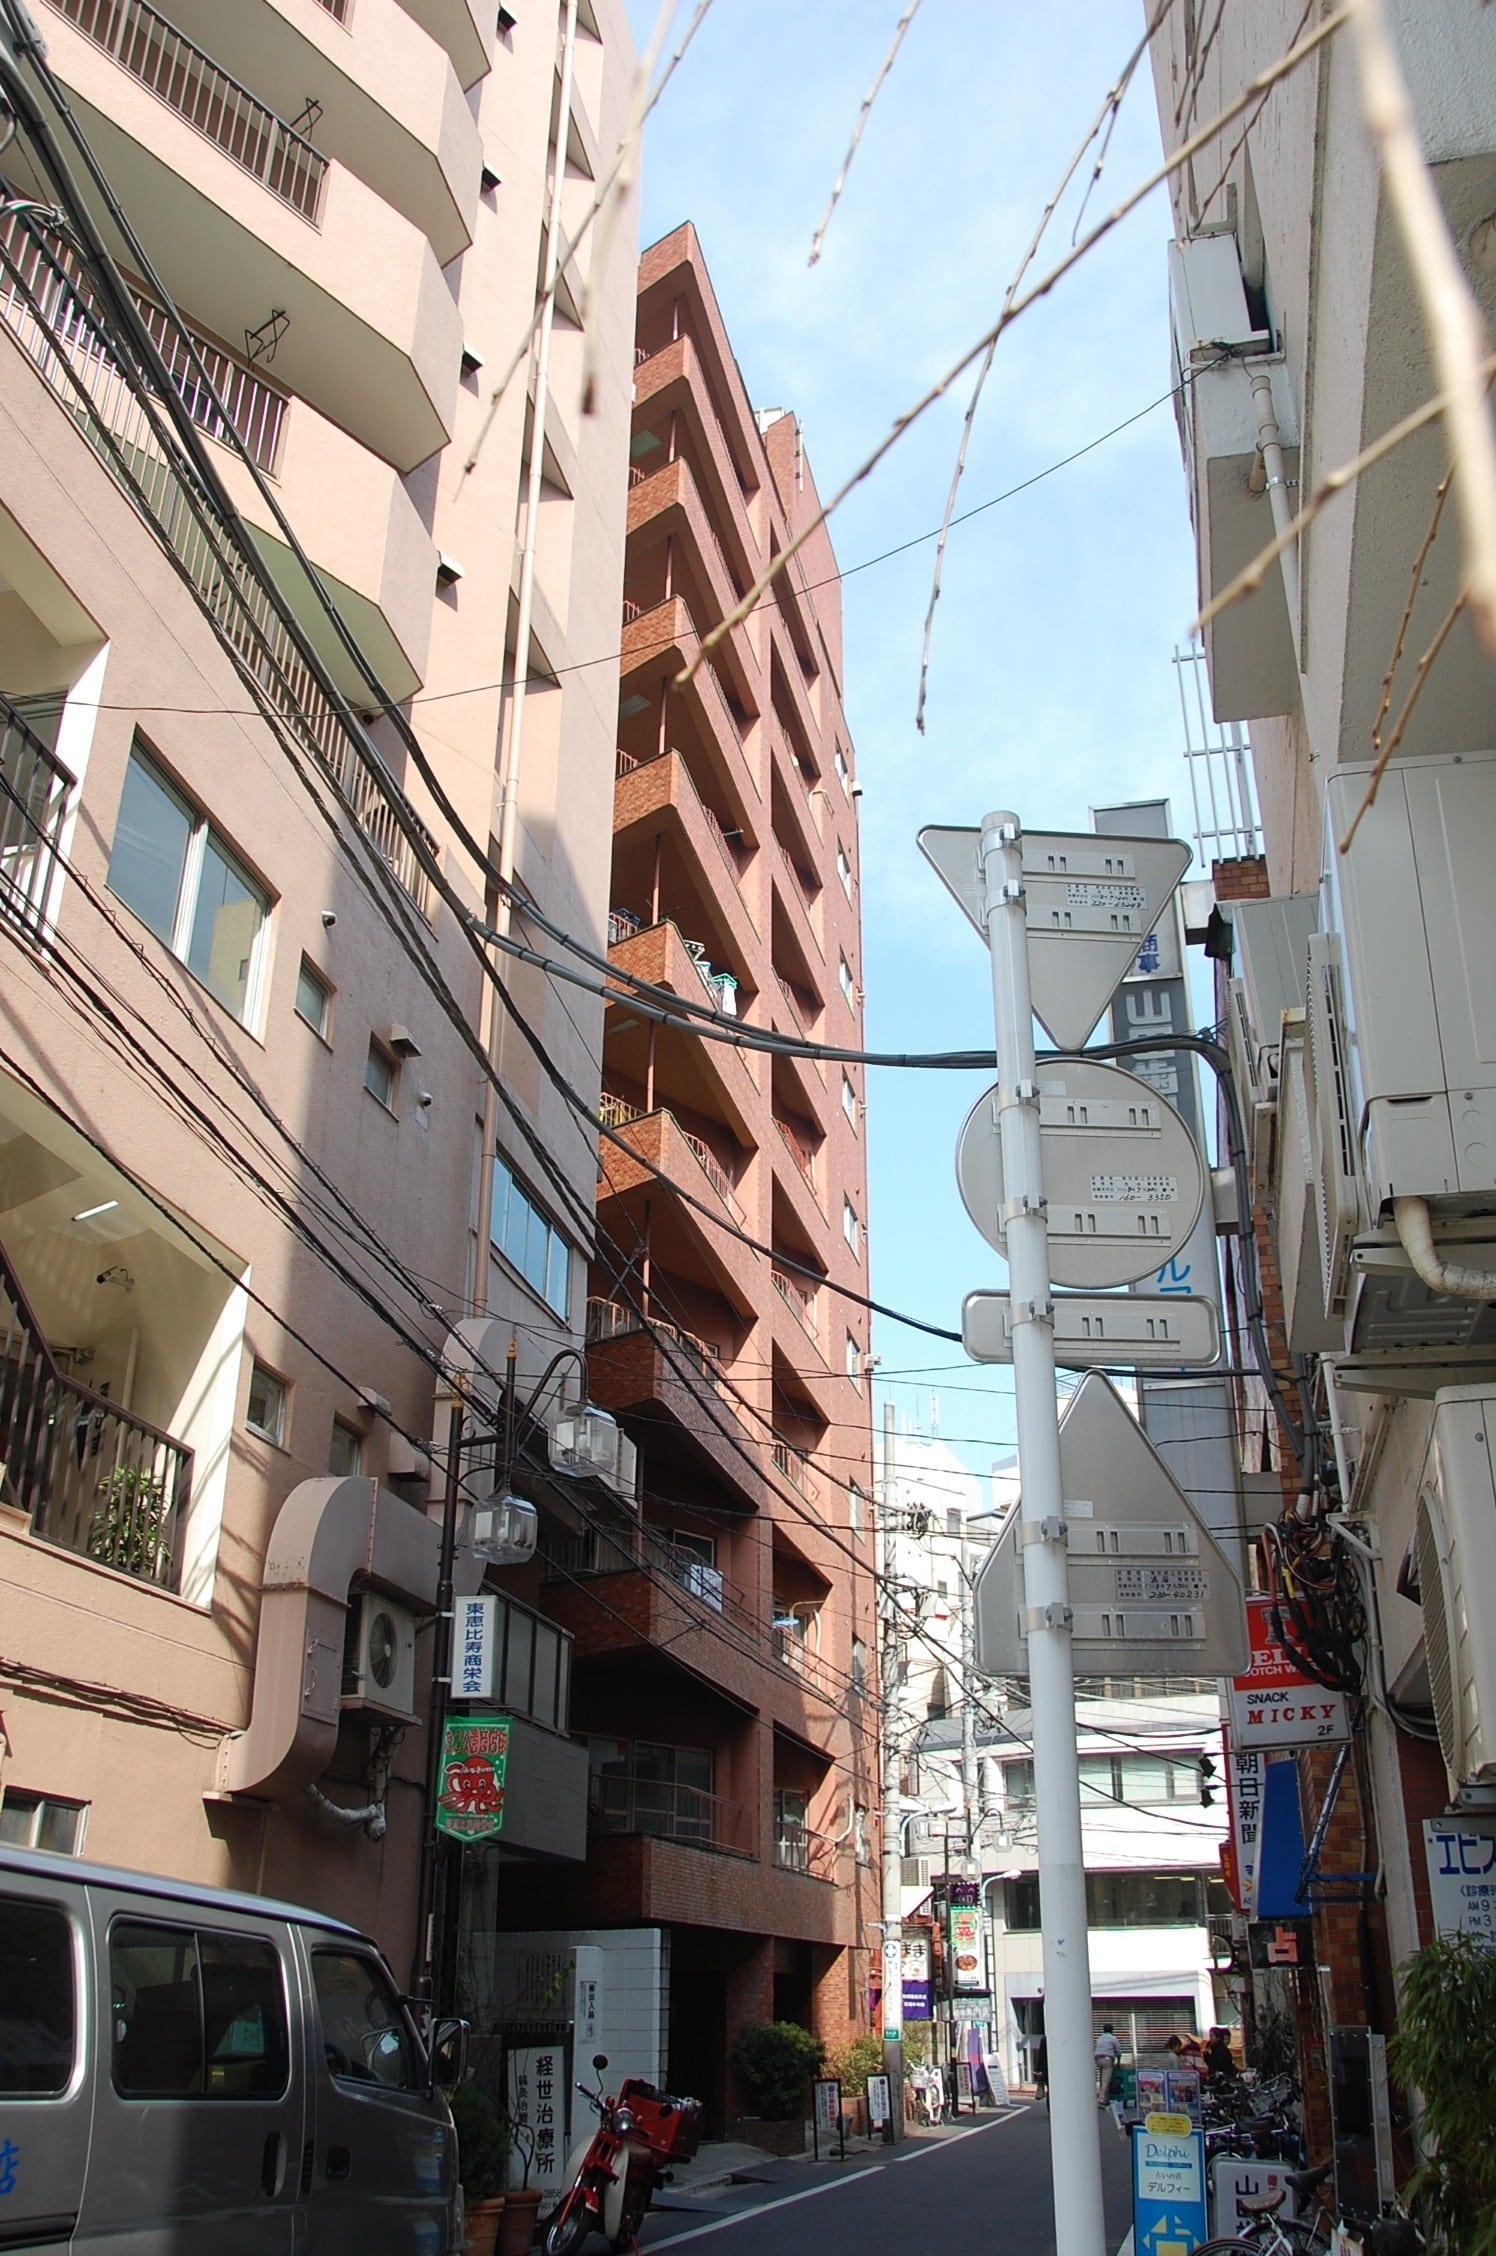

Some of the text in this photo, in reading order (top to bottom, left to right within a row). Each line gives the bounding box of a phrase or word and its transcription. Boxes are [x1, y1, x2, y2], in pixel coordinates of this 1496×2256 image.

[463, 1602, 485, 1693] 東恵比寿商栄会
[1246, 1691, 1289, 1705] SNACK
[1247, 1704, 1336, 1725] MICKY
[1317, 1724, 1334, 1736] 2F
[1235, 1754, 1261, 1845] 朝日新聞
[1468, 1901, 1479, 1911] AM
[1469, 1917, 1481, 1926] PM
[1267, 1926, 1298, 1963] 占
[536, 2055, 555, 2174] 経世治療所
[1145, 2143, 1189, 2161] Delphi
[1147, 2182, 1192, 2194] デルフィー
